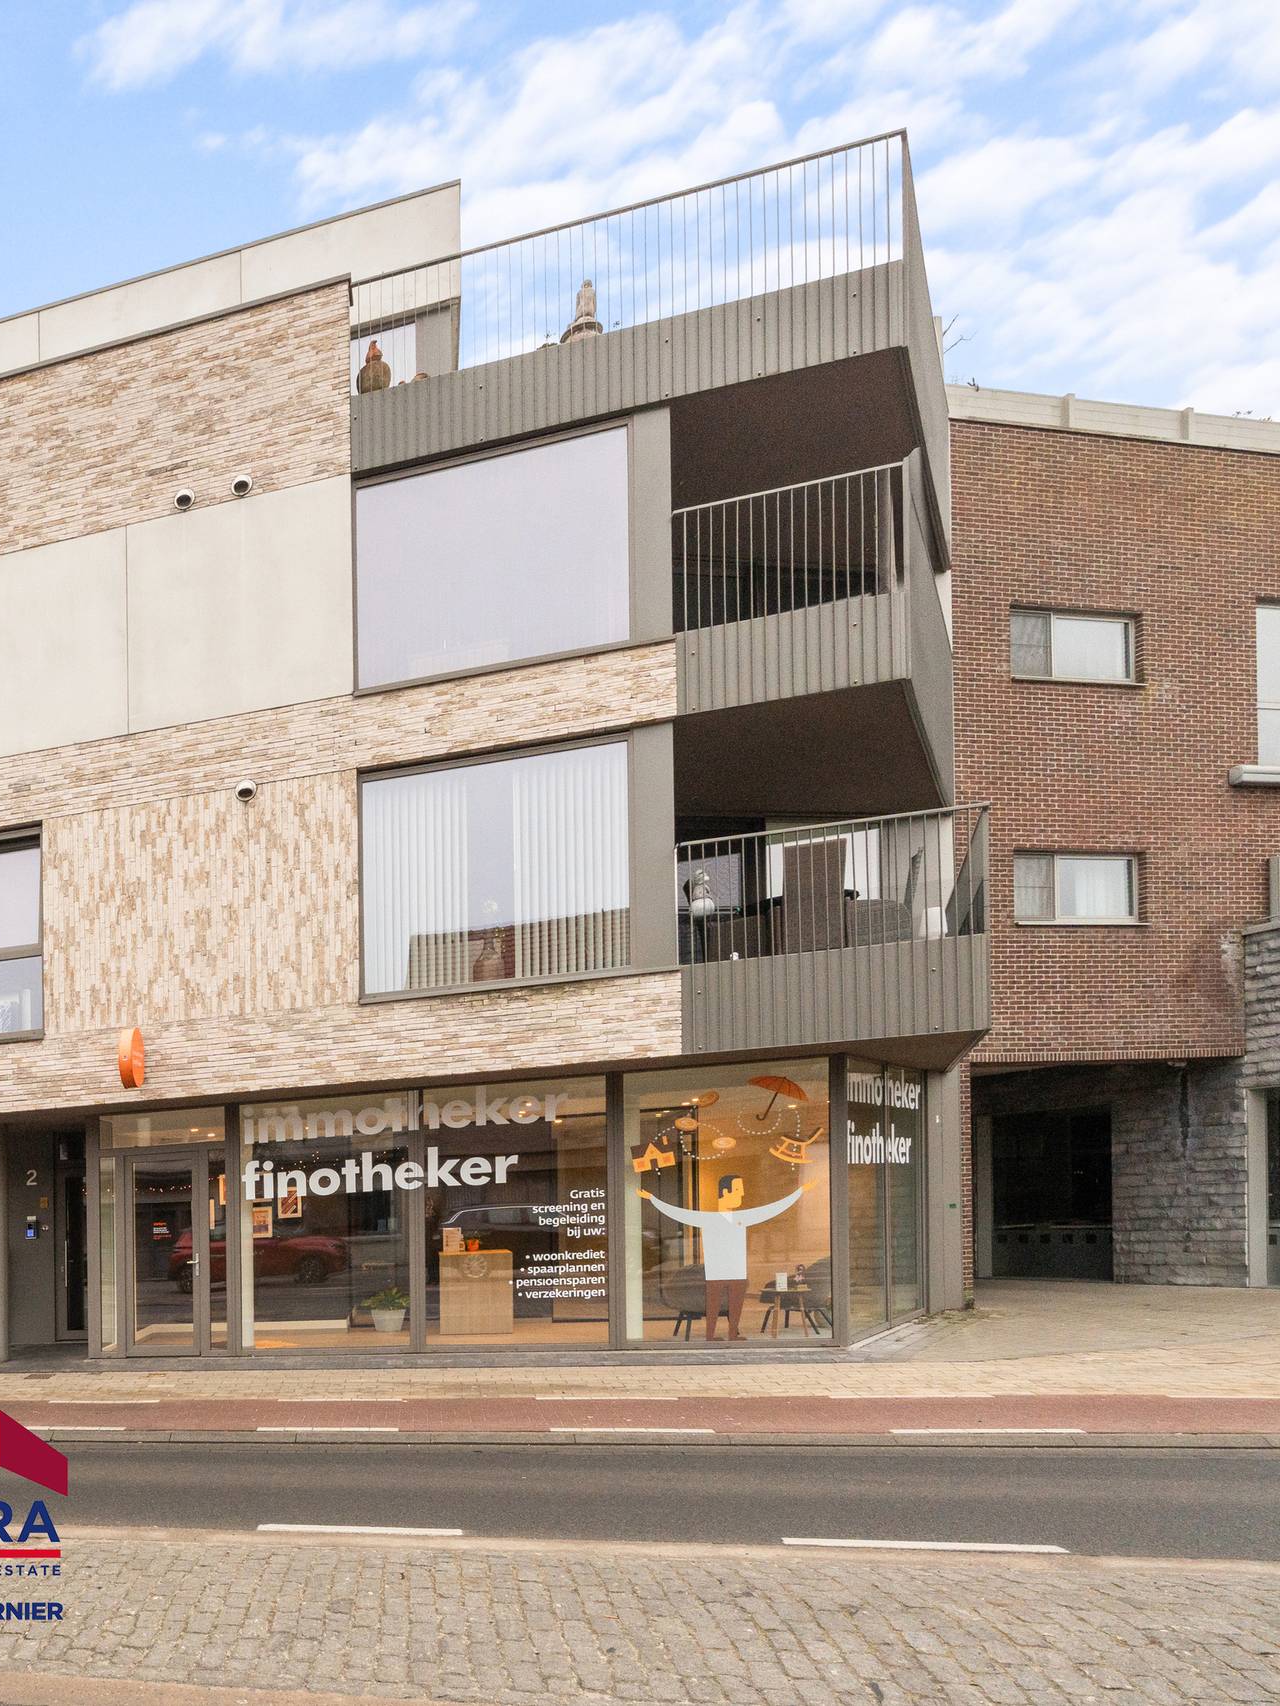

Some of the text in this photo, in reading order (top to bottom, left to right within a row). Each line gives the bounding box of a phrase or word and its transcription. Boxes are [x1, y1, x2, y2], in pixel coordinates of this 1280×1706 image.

[847, 1070, 921, 1110] immoheker
[242, 1086, 569, 1145] immotheker
[847, 1119, 912, 1165] finotheker
[26, 1169, 38, 1186] 2
[241, 1146, 519, 1201] finotheker
[569, 1188, 605, 1199] Gratis
[532, 1202, 605, 1214] screening en
[538, 1214, 605, 1227] begeleiding
[567, 1227, 606, 1238] bij uw:
[532, 1250, 605, 1261] woonkrediet
[527, 1263, 605, 1275] spaarplannen
[516, 1276, 605, 1288] pensioensparen
[525, 1288, 605, 1299] verzekeringen
